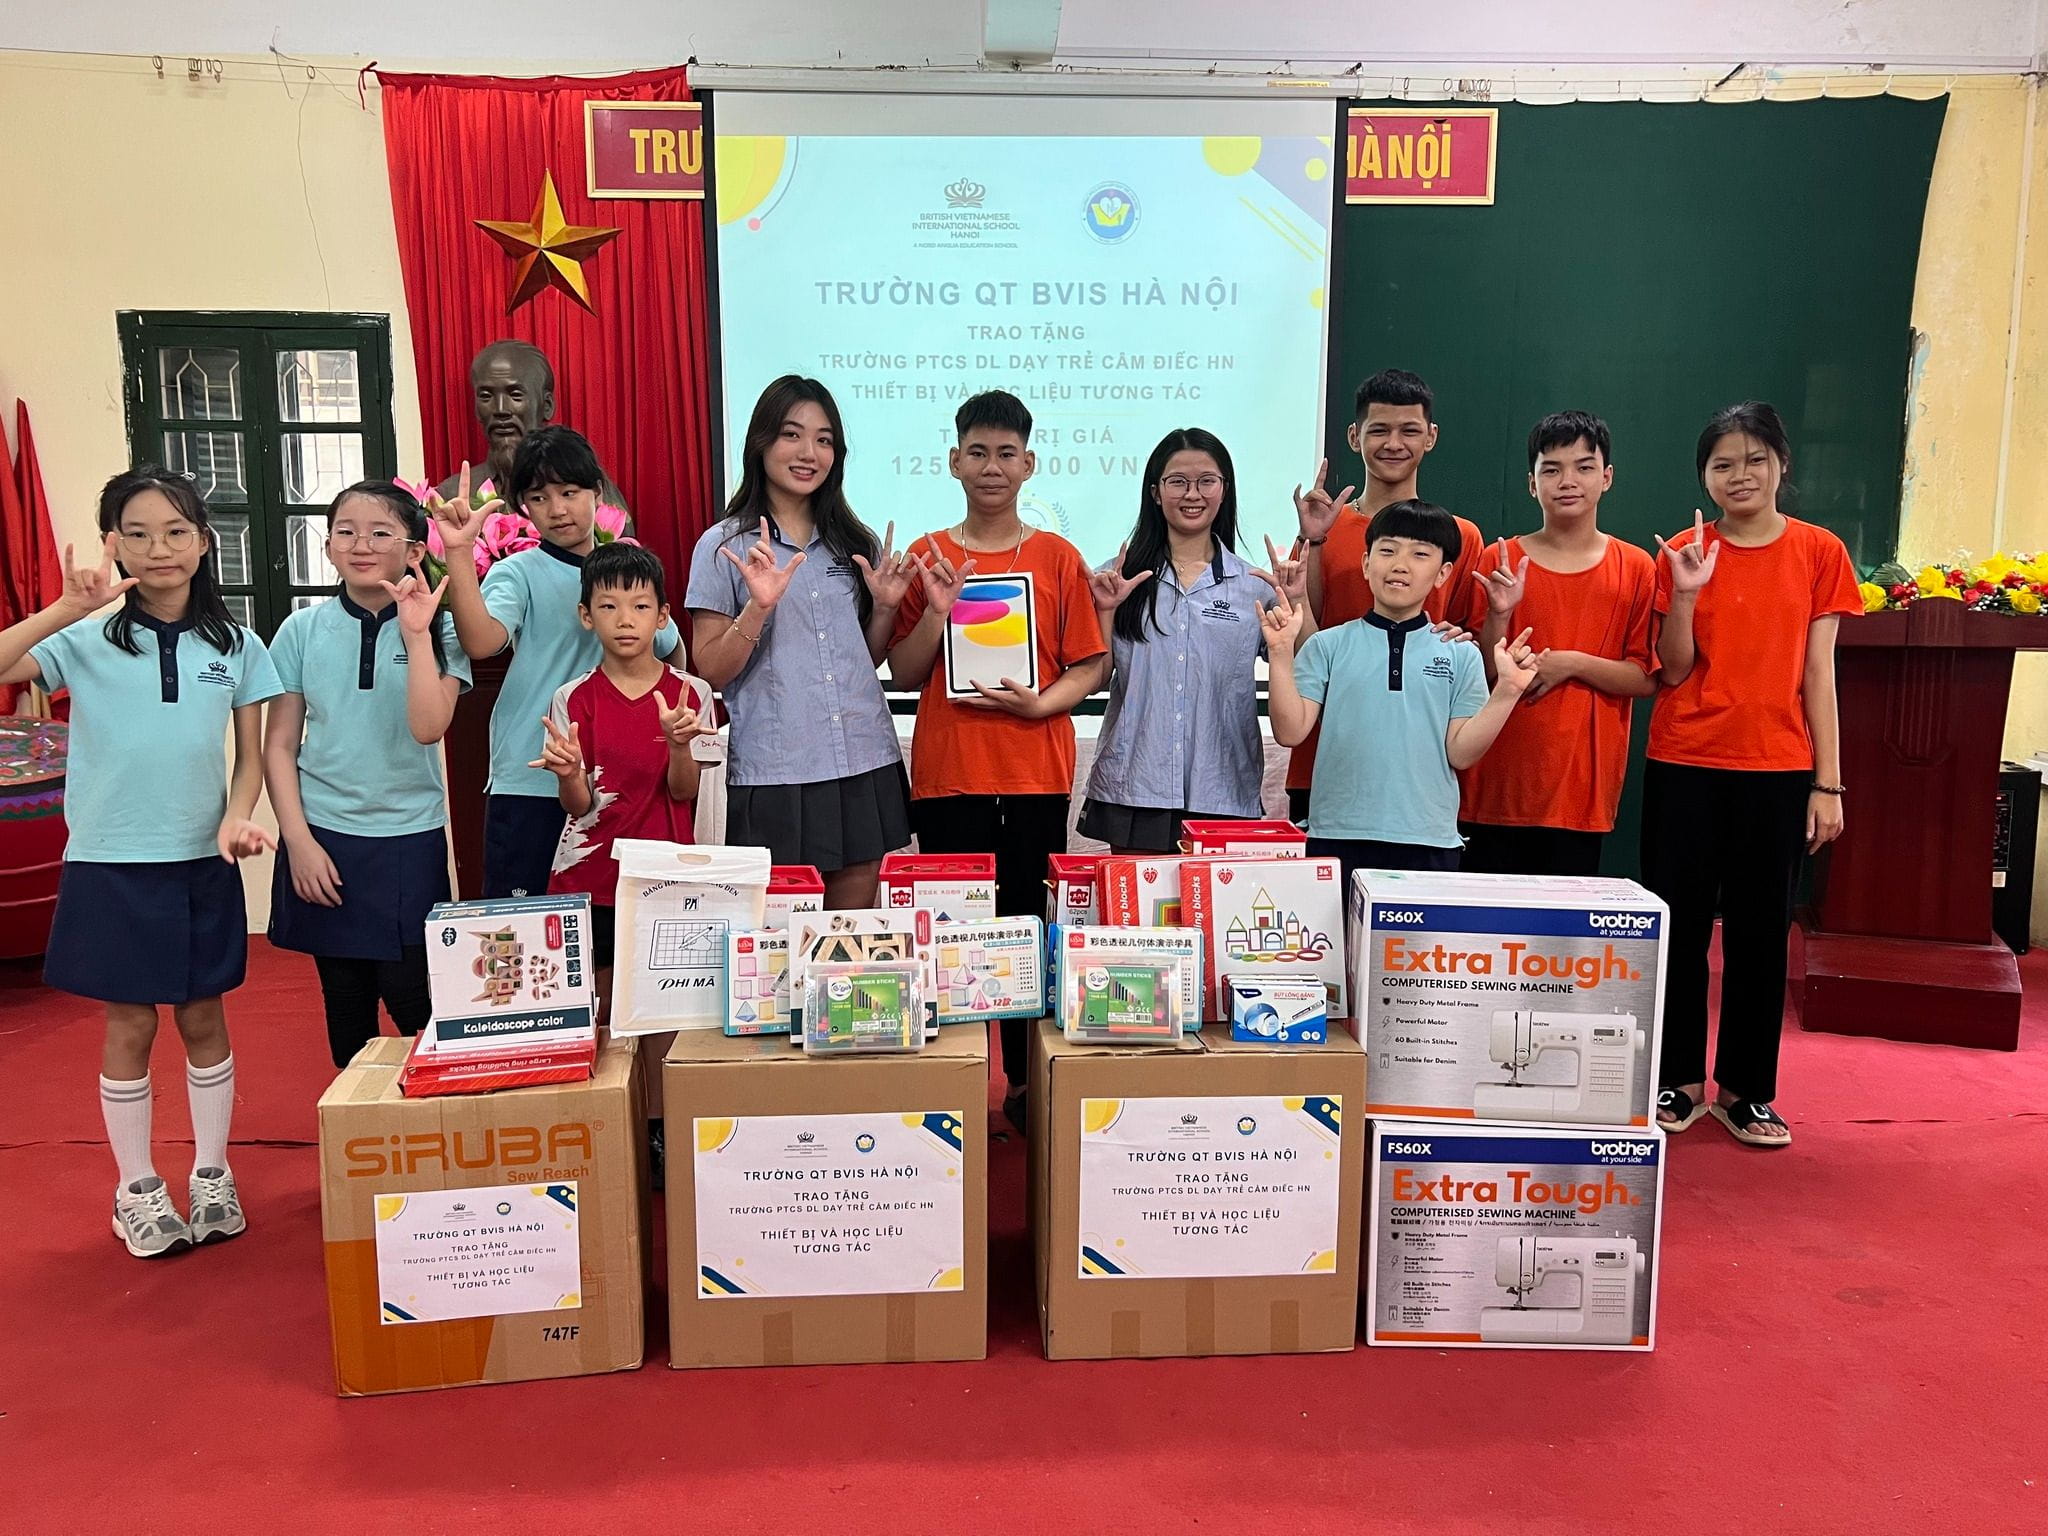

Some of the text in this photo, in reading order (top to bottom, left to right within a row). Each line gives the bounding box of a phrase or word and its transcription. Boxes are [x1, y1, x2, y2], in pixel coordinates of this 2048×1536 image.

[815, 276, 1238, 311] TRƯỜNG QT BVIS HÀ NỘI
[967, 322, 1085, 343] TRAO TẶNG
[819, 351, 1234, 373] TRƯỜNG PTCS DL DẠY TRẺ CÂM ĐIẾC HN
[852, 381, 907, 399] THIẾT
[916, 385, 936, 402] BỊ
[945, 382, 970, 399] VÀ
[1030, 382, 1071, 403] LIỆU
[1081, 385, 1154, 399] TƯƠNG
[1163, 383, 1201, 399] TÁC
[1073, 425, 1114, 444] GIÁ
[1119, 875, 1129, 910] blocks
[1192, 876, 1201, 909] blocks
[1379, 911, 1424, 923] FS60X
[1590, 912, 1655, 928] brother
[1383, 938, 1641, 989] Extra Tough.
[693, 976, 715, 987] MÃ
[1382, 978, 1574, 993] COMPUTERISED SEWING MACHINE
[1397, 998, 1417, 1006] Heavy
[463, 1016, 564, 1035] Kaleidoscope color
[448, 1064, 476, 1073] blocks
[478, 1061, 510, 1071] building
[1128, 1148, 1298, 1162] TRƯỜNG QT BVIS HÀ NỘI
[1388, 1143, 1432, 1154] FS60X
[1592, 1141, 1654, 1156] brother
[507, 1165, 590, 1184] Sew Reach
[744, 1165, 919, 1181] TRƯỜNG QT BVIS HÀ NỘI
[1176, 1174, 1210, 1183] TRAO
[794, 1190, 870, 1202] TRAO TẶNG
[1393, 1168, 1643, 1213] Extra Tough.
[807, 1205, 820, 1213] DL
[1182, 1211, 1195, 1222] BỊ
[1200, 1209, 1216, 1220] VÀ
[1222, 1210, 1248, 1221] HỌC
[1391, 1208, 1576, 1219] COMPUTERISED SEWING MACHINE
[463, 1229, 476, 1237] QT
[481, 1226, 504, 1235] BVIS
[802, 1230, 816, 1240] BỊ
[821, 1227, 837, 1238] VÀ
[843, 1228, 870, 1239] HỌC
[1173, 1224, 1249, 1235] TƯƠNG TÁC
[451, 1244, 478, 1253] TRAO
[793, 1242, 872, 1254] TƯƠNG TÁC
[542, 1326, 580, 1341] 747F
